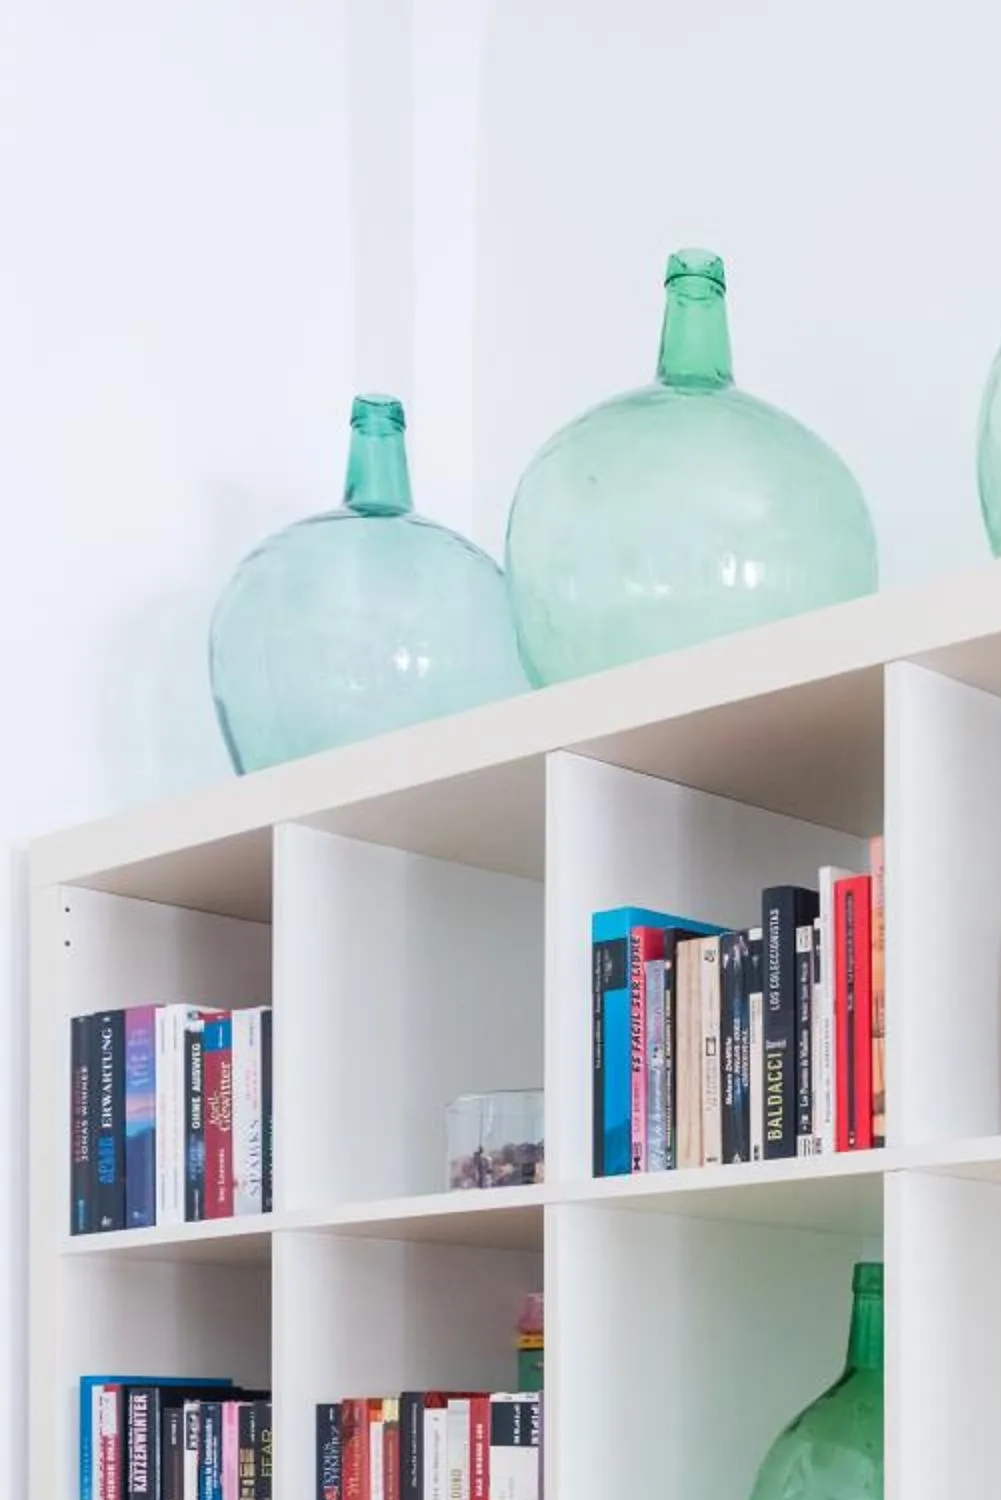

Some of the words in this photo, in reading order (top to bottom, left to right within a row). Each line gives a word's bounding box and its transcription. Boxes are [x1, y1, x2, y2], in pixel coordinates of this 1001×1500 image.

[768, 907, 780, 989] COLECCIONISTAS
[769, 991, 781, 1011] LOS
[100, 1027, 113, 1129] ERWARTUNG
[191, 1097, 202, 1129] OHNE
[766, 1053, 783, 1141] BALDACCI
[133, 1394, 148, 1493] KATZENWINTER
